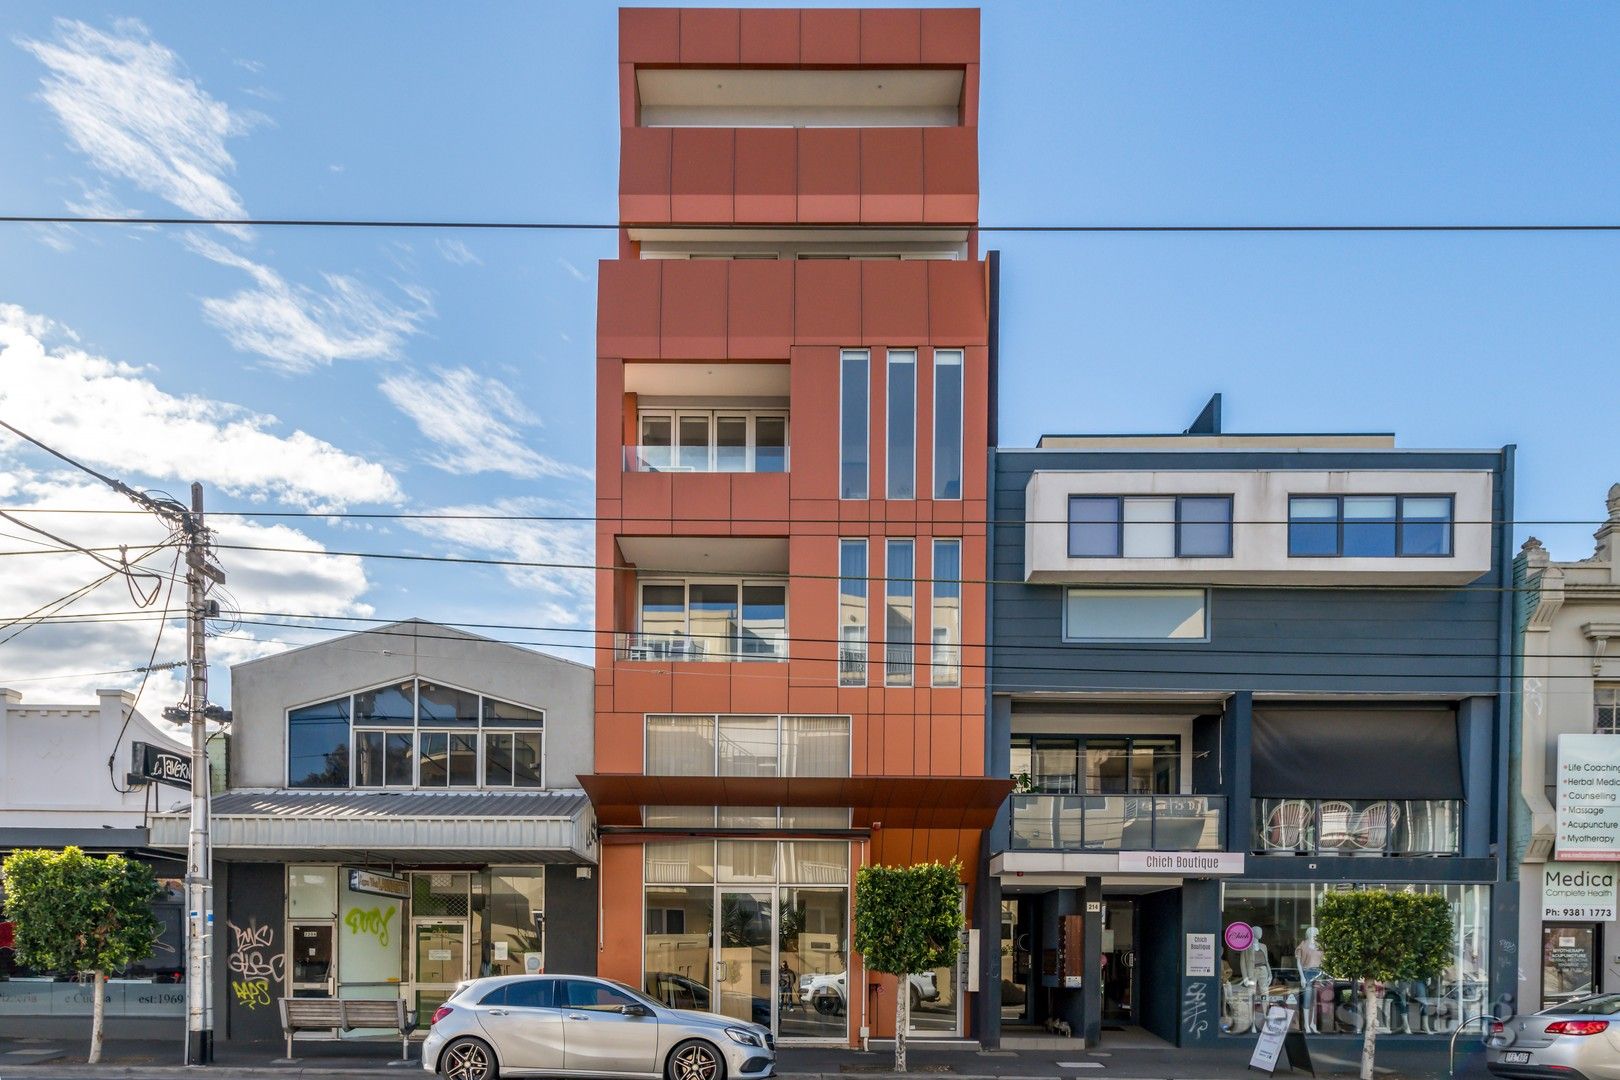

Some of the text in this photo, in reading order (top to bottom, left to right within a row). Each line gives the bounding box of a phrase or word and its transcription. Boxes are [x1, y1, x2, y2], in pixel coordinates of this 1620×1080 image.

[1568, 763, 1620, 774] Life Coaching
[1568, 778, 1594, 786] Herbal
[1568, 792, 1616, 801] Counselling
[1568, 806, 1604, 816] Massage
[1567, 821, 1618, 830] Acupuncture
[1567, 834, 1614, 844] Myotherapy
[1146, 856, 1219, 869] Chich Boutique
[1546, 870, 1612, 887] Medica
[1545, 889, 1612, 897] Complete Health
[1545, 908, 1612, 917] Ph: 9381 1773
